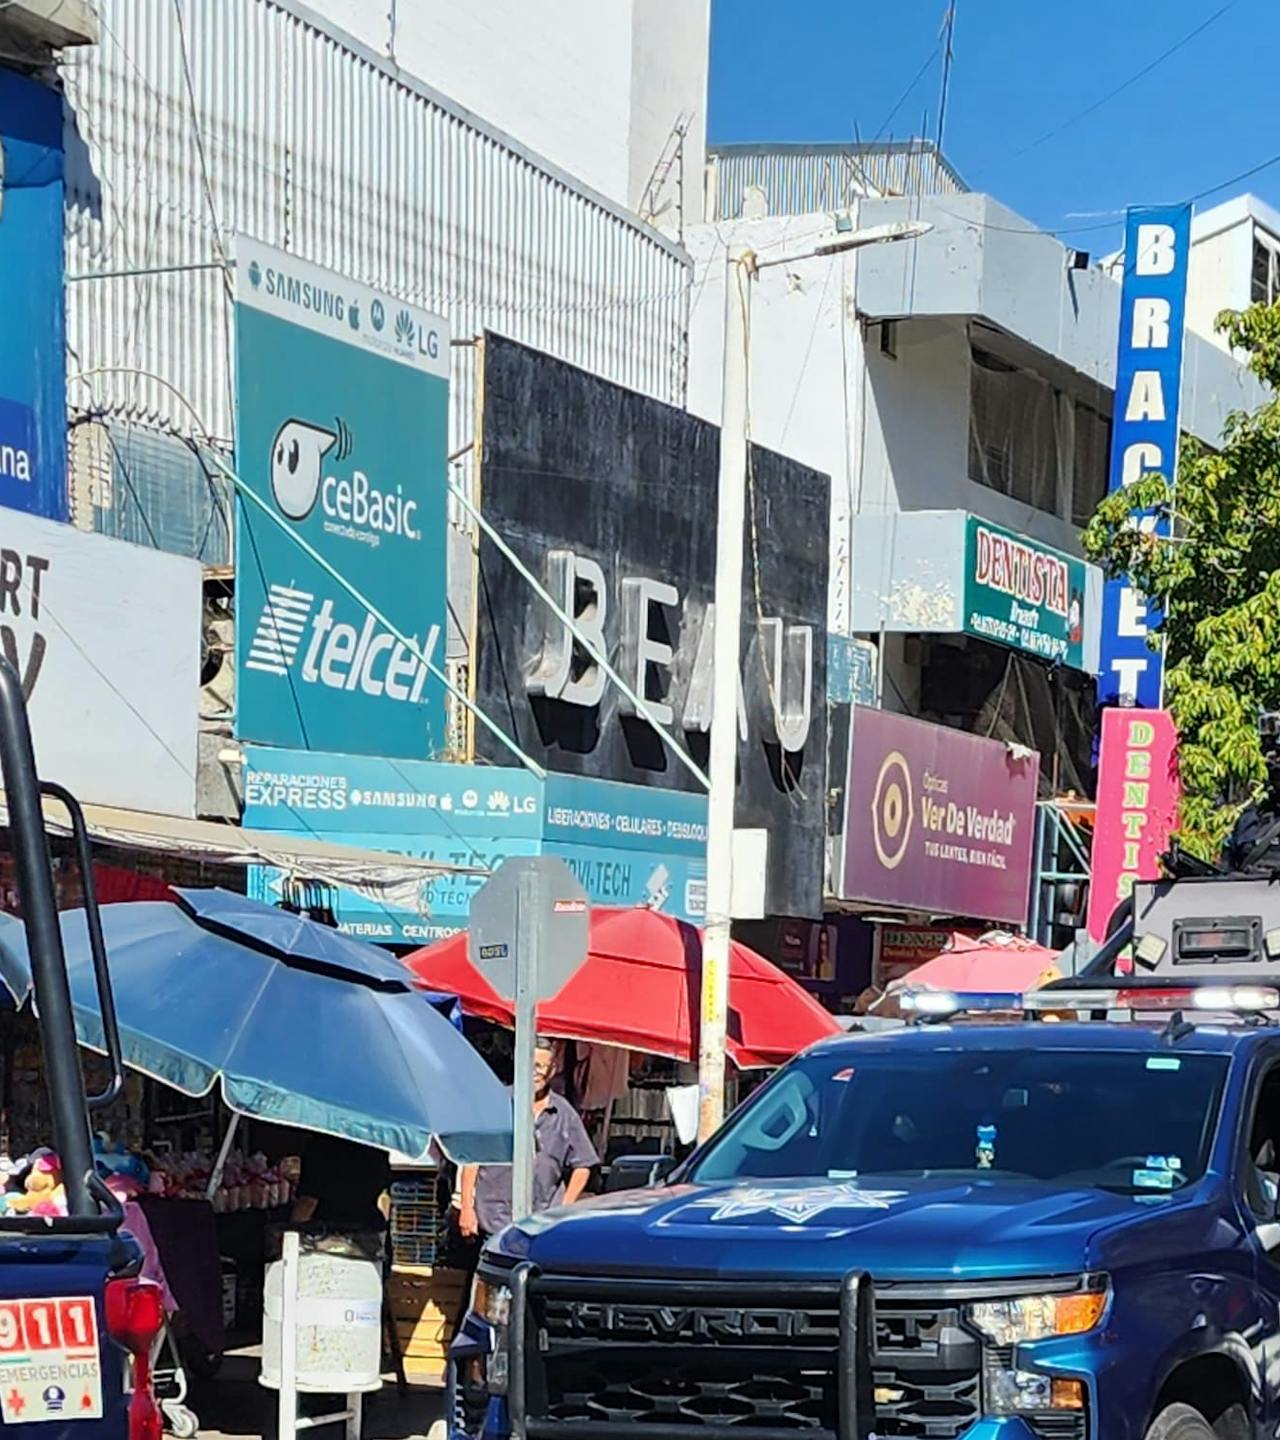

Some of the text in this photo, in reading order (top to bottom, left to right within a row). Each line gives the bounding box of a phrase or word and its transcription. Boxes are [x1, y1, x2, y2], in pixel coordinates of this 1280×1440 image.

[266, 267, 344, 322] SAMSUNG
[418, 324, 439, 360] LG
[976, 526, 1068, 617] DENTISTA
[302, 599, 440, 703] telcel
[245, 785, 537, 814] EXPRESS SAMSUNG LG
[246, 772, 347, 791] REPARACIONES
[1116, 720, 1155, 899] DENTIS
[547, 806, 610, 831] LIBERACIONES
[615, 815, 663, 837] CELULARES
[922, 796, 1013, 846] Ver De Verdad
